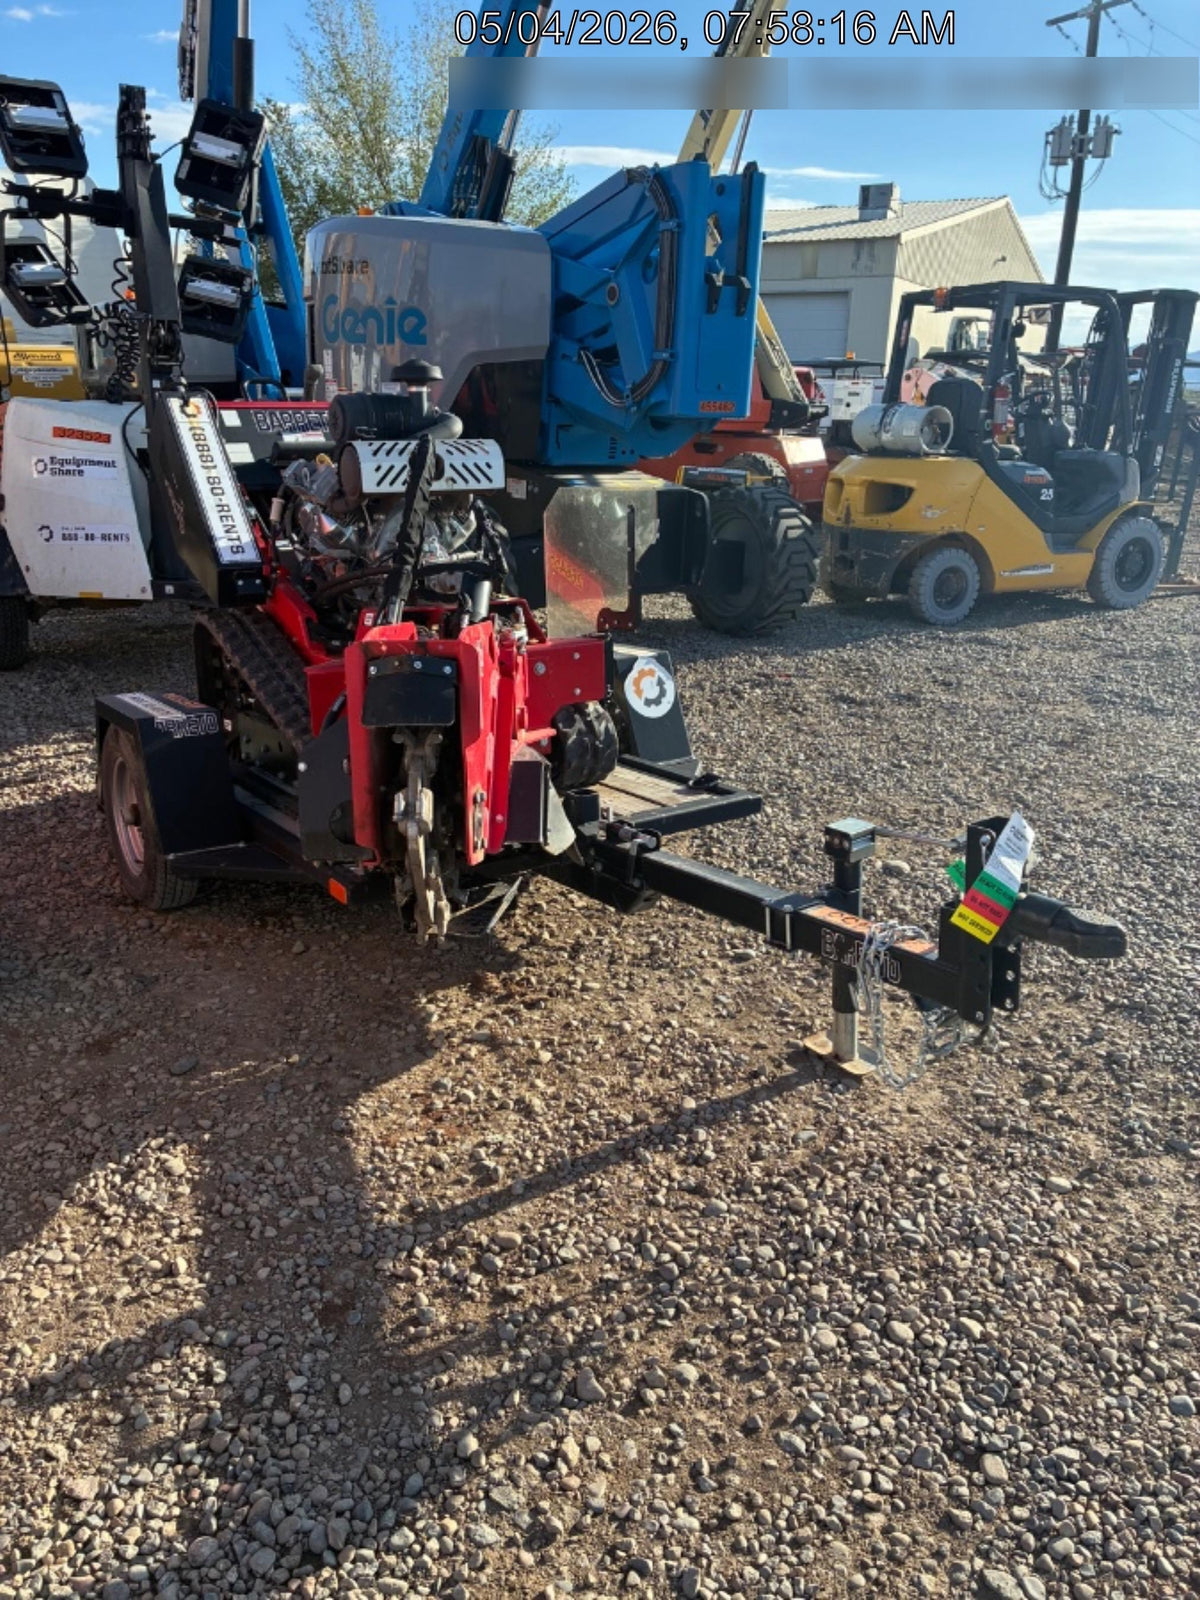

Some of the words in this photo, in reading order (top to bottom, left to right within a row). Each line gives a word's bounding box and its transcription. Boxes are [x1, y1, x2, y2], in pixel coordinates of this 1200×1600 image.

[323, 294, 428, 346] Genie
[48, 456, 117, 468] Equipment
[48, 467, 84, 477] Share
[188, 425, 218, 470] (888)
[206, 475, 246, 555] 80-RENTS
